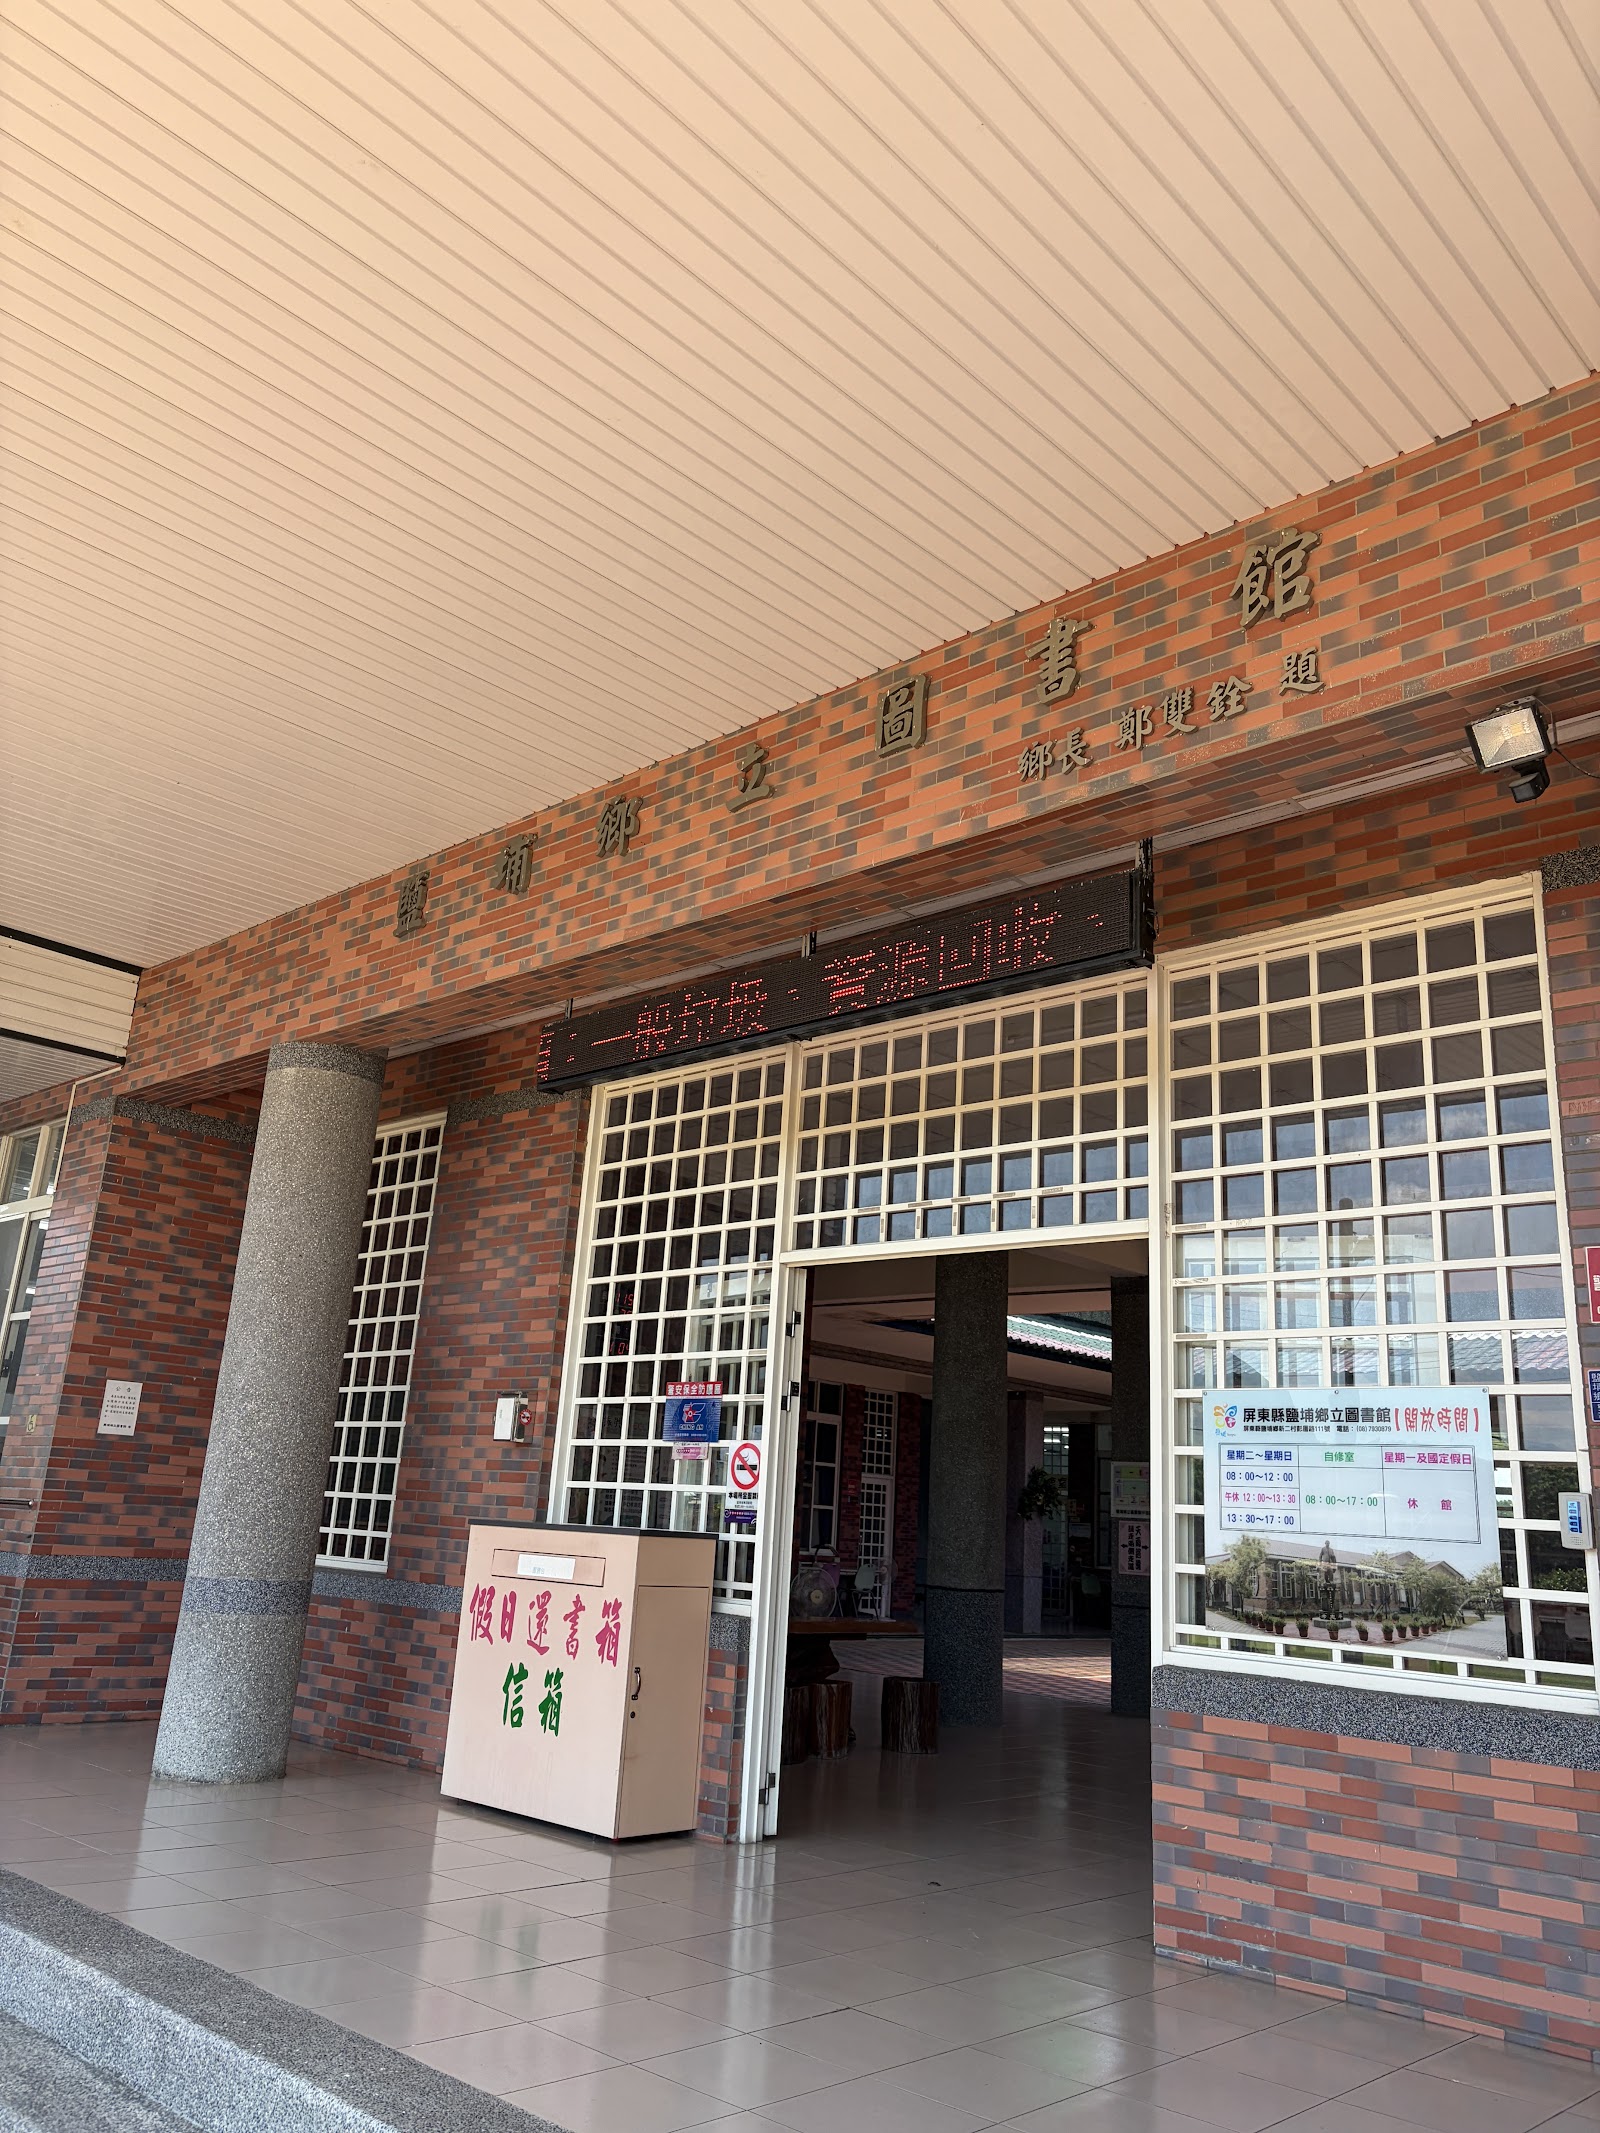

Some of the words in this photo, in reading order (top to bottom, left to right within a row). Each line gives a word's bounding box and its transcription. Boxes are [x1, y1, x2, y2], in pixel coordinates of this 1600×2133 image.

[393, 527, 1322, 938] 鹽埔鄉立圖書館
[1017, 727, 1094, 782] 鄉長
[1114, 675, 1254, 751] 鄭雙銓
[1279, 647, 1326, 697] 題
[1243, 1407, 1391, 1423] 屏東縣鹽埔鄉立圖書館
[1324, 1451, 1355, 1463] 自修室
[1384, 1451, 1473, 1465] 星期一及國定假日
[1225, 1491, 1240, 1502] 午休
[469, 1583, 623, 1667] 假日還書箱
[502, 1662, 564, 1737] 信箱
